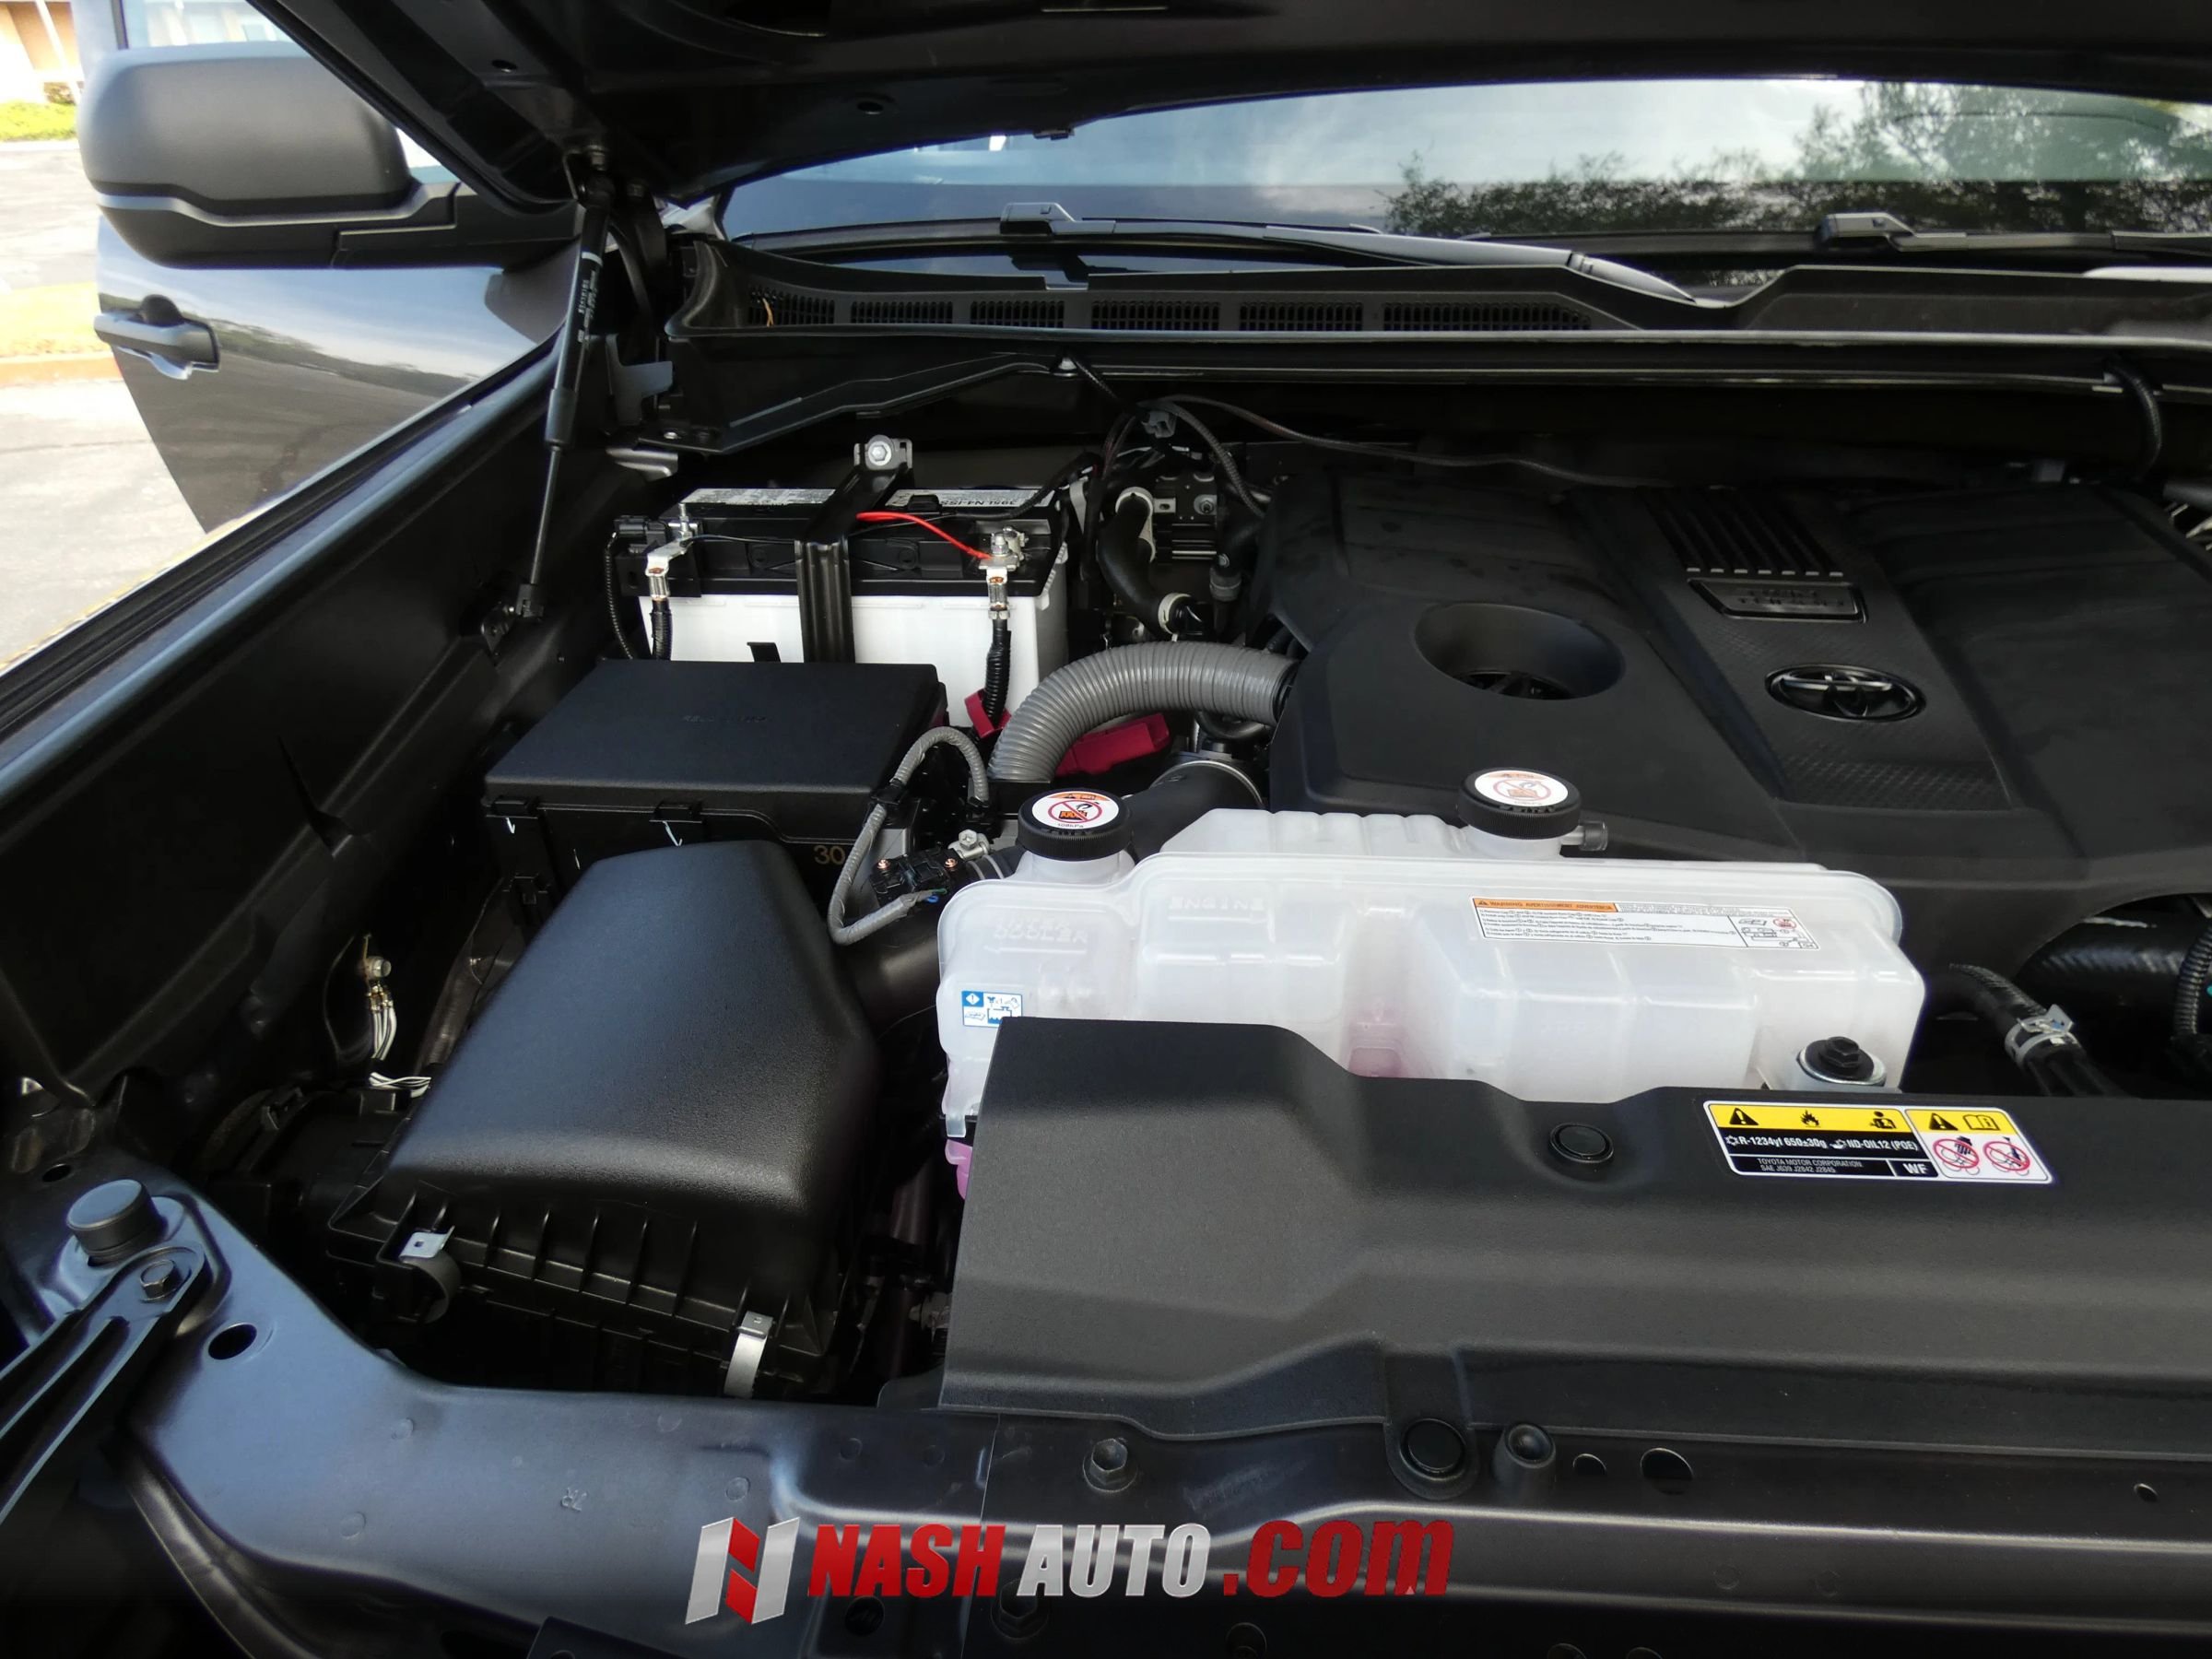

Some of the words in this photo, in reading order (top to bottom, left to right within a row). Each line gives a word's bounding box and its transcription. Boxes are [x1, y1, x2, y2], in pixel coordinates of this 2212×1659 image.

[813, 844, 846, 865] 30
[1738, 1136, 1783, 1147] R-1234yf
[1783, 1137, 1828, 1148] 650±30g
[1847, 1139, 1889, 1148] ND-OIL12
[1890, 1140, 1918, 1151] (POE)
[1903, 1163, 1928, 1173] WF
